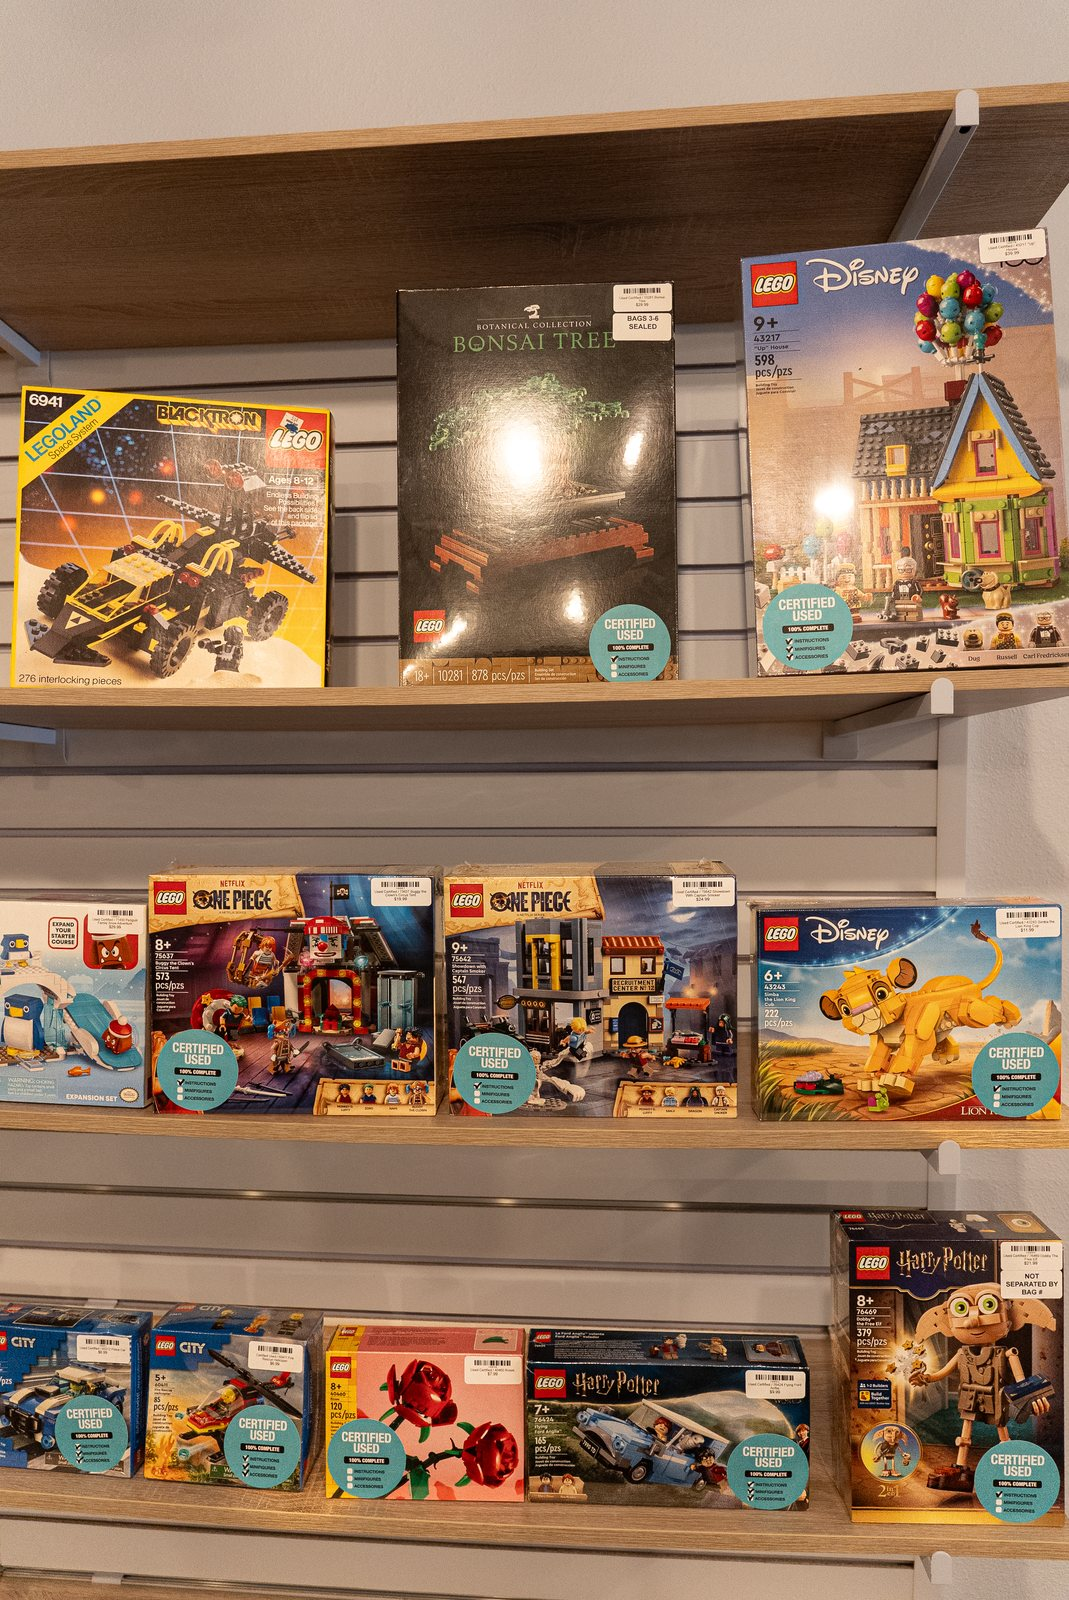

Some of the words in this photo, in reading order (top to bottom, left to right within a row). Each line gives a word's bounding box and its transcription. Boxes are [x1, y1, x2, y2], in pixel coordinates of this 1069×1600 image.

[755, 275, 795, 292] LEGO
[477, 321, 529, 330] BOTANICAL
[533, 320, 592, 329] COLLECTION
[754, 316, 778, 331] 9+
[453, 334, 544, 353] BONSAI
[553, 331, 616, 349] TREE
[754, 334, 780, 342] 43217
[755, 354, 774, 366] 598
[756, 365, 792, 379] pcs/pzs
[29, 394, 62, 408] 6941
[156, 404, 262, 431] BLACKTRON
[25, 398, 101, 462] LEGOLAND
[48, 438, 73, 460] Space
[71, 418, 98, 441] System
[269, 429, 322, 451] LEGO
[269, 476, 291, 485] Ages
[294, 477, 314, 485] 8-12
[779, 597, 835, 610] CERTIFIED
[793, 610, 822, 621] USED
[415, 620, 443, 634] LEGO
[605, 618, 656, 629] CERTIFIED
[617, 630, 643, 640] USED
[19, 674, 36, 682] 276
[39, 675, 90, 685] interlocking
[92, 677, 121, 685] pieces
[415, 670, 429, 681] 18+
[438, 670, 463, 681] 10281
[472, 669, 488, 681] 878
[492, 668, 526, 683] pcs/pzs
[156, 891, 185, 905] LEGO
[233, 890, 272, 910] PIECE
[453, 893, 482, 907] LEGO
[531, 891, 571, 911] PIECE
[766, 927, 798, 941] LEGO
[155, 939, 171, 950] 8+
[452, 942, 468, 953] 9+
[156, 972, 169, 980] 573
[452, 976, 466, 984] 547
[764, 970, 782, 981] 6+
[156, 981, 184, 991] pcs/pzs
[453, 984, 482, 994] pcs/pzs
[765, 1018, 792, 1028] pcs/pzs
[173, 1042, 224, 1054] CERTIFIED
[469, 1046, 521, 1058] CERTIFIED
[989, 1047, 1044, 1058] CERTIFIED
[185, 1054, 211, 1065] USED
[481, 1058, 508, 1068] USED
[1002, 1059, 1031, 1069] USED
[66, 1094, 104, 1102] EXPANSION
[961, 1106, 987, 1115] LION
[858, 1255, 888, 1270] LEGO
[896, 1249, 941, 1278] Harry
[942, 1246, 988, 1273] Potter
[857, 1295, 874, 1306] 8+
[857, 1329, 871, 1337] 379
[156, 1341, 174, 1350] LEGO
[857, 1337, 887, 1347] pcs/pzs
[332, 1363, 350, 1372] LEGO
[536, 1377, 565, 1389] LEGO
[572, 1372, 615, 1396] Harry
[617, 1370, 660, 1396] Potter
[153, 1402, 178, 1412] pcs/pzs
[535, 1404, 550, 1415] 7+
[66, 1408, 112, 1419] CERTIFIED
[331, 1410, 356, 1420] pcs/pzs
[78, 1419, 102, 1429] USED
[239, 1418, 287, 1431] CERTIFIED
[250, 1430, 275, 1441] USED
[341, 1432, 391, 1443] CERTIFIED
[535, 1437, 546, 1445] 165
[354, 1443, 380, 1453] USED
[535, 1444, 561, 1453] pcs/pzs
[743, 1447, 794, 1457] CERTIFIED
[755, 1458, 782, 1468] USED
[991, 1454, 1045, 1466] CERTIFIED
[1004, 1466, 1032, 1477] USED
